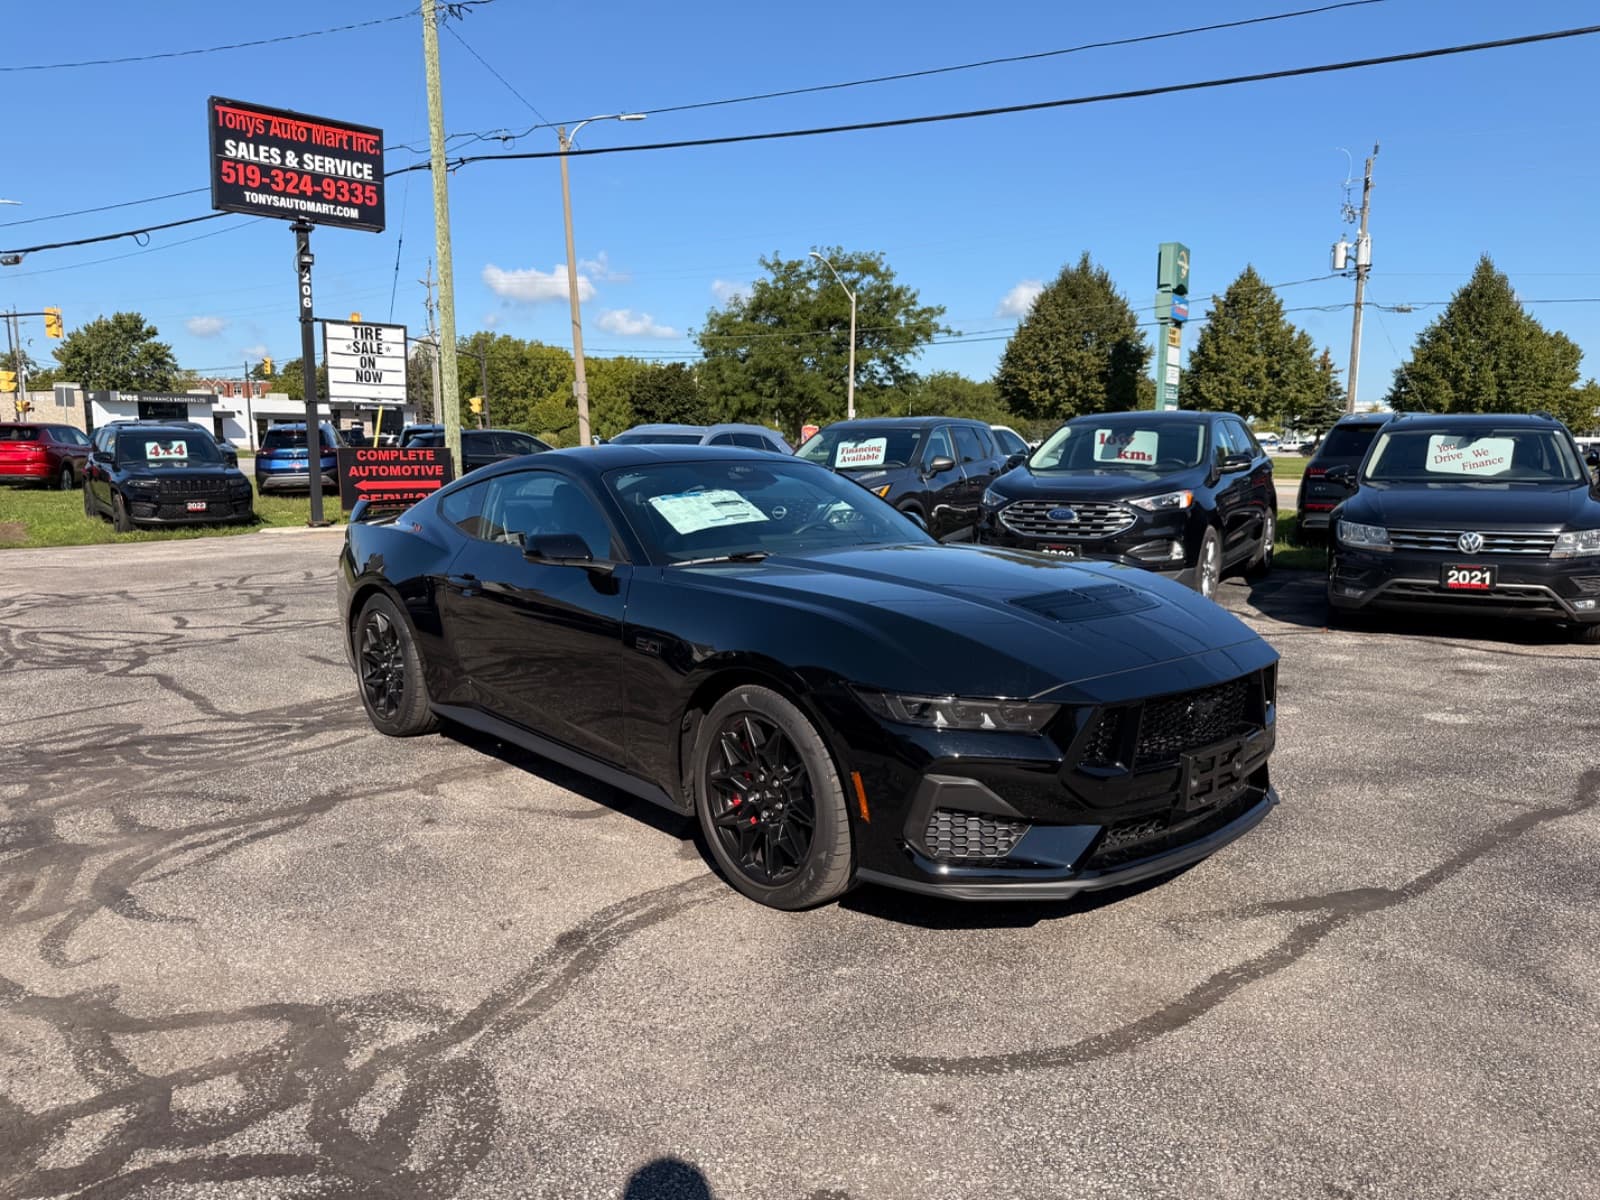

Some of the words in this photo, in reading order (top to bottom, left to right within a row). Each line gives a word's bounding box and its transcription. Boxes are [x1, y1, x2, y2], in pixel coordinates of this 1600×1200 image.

[215, 105, 265, 138] Tonys
[269, 117, 308, 143] Auto
[311, 124, 348, 149] Mart
[349, 132, 380, 155] Inc.
[225, 139, 281, 167] SALES
[285, 150, 300, 169] &
[303, 153, 373, 180] SERVICE
[221, 160, 378, 207] 519-324-9335
[244, 191, 359, 219] TONYSAUTOMART.COM
[352, 326, 383, 341] TIRE
[352, 341, 384, 355] SALE
[360, 356, 376, 369] ON
[355, 370, 383, 383] NOW
[841, 445, 882, 455] Financing
[1437, 443, 1457, 453] You
[356, 450, 435, 461] COMPLETE
[841, 453, 880, 463] Available
[1434, 452, 1463, 464] Drive
[1472, 448, 1489, 458] We
[1462, 456, 1504, 471] Finance
[348, 465, 444, 477] AUTOMOTIVE
[1447, 570, 1491, 585] 2021
